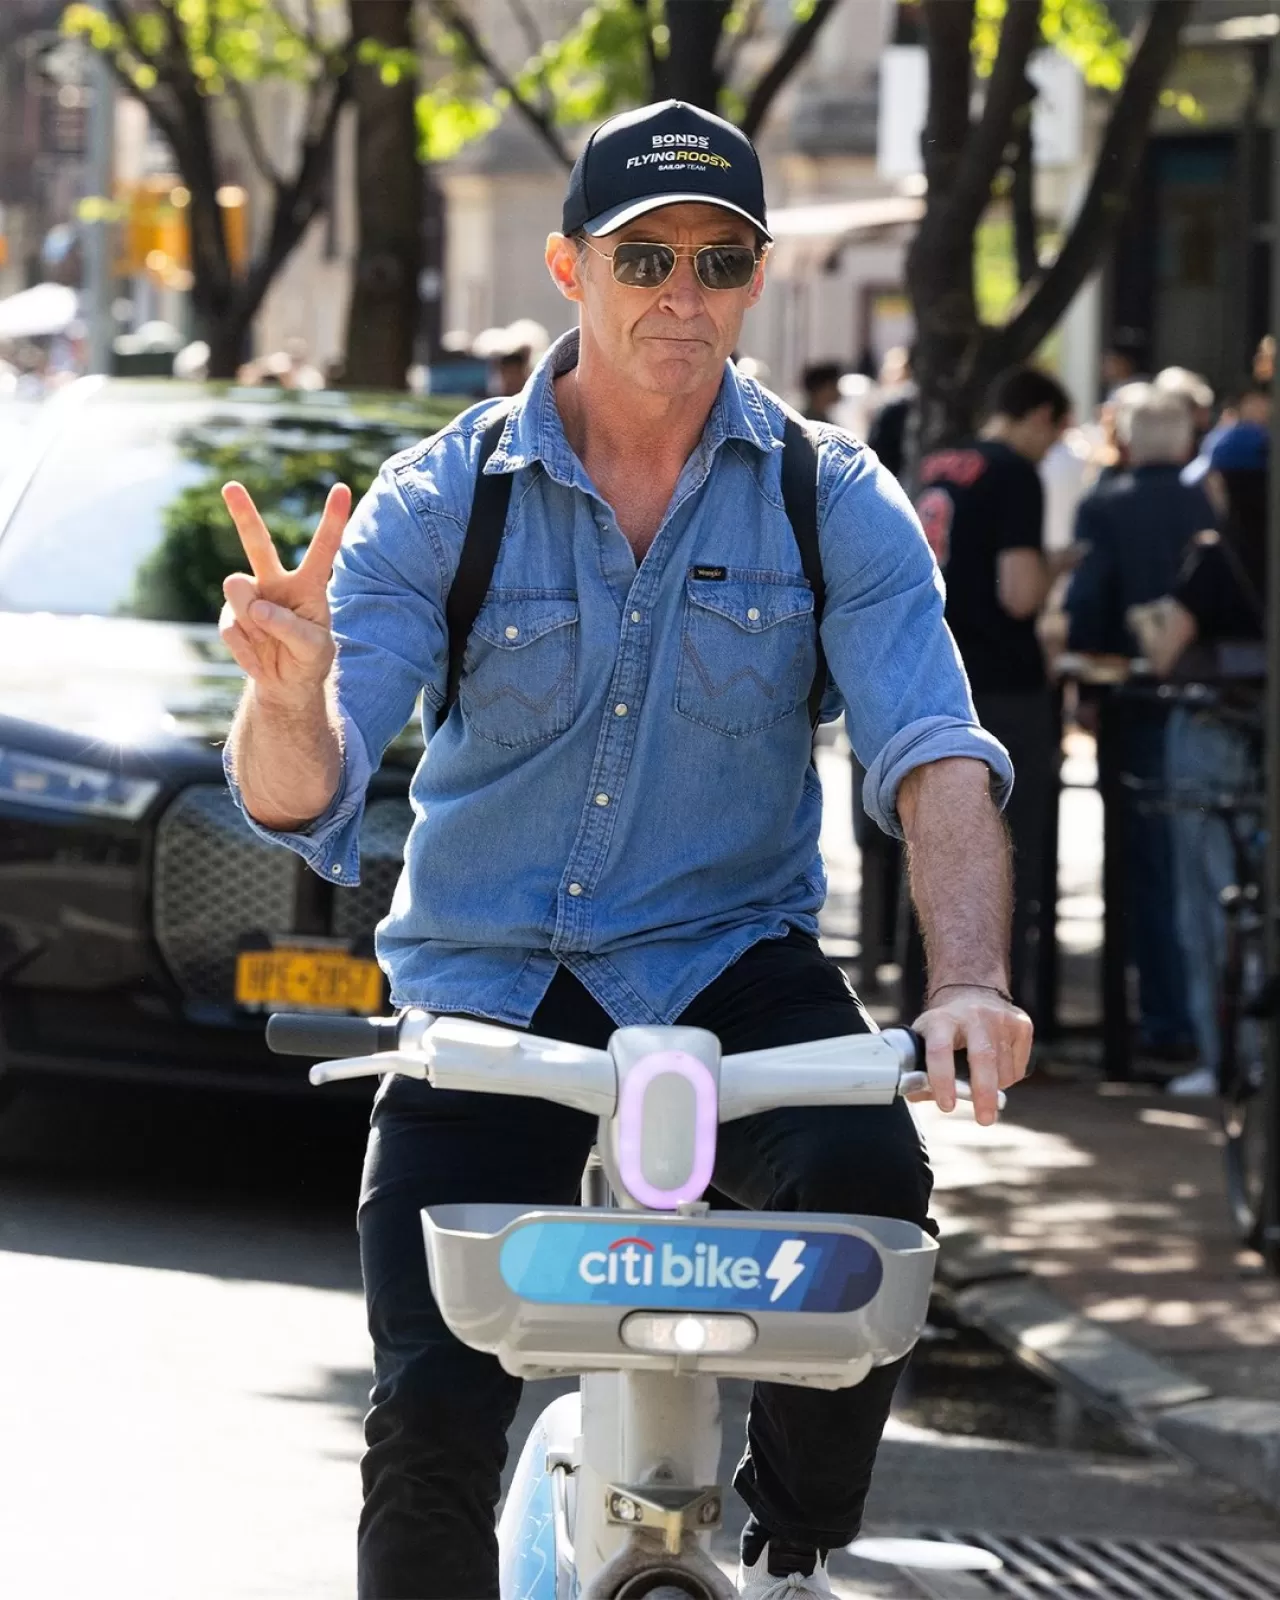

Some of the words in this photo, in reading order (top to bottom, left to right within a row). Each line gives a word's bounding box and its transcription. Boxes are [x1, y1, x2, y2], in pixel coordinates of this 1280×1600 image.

[652, 134, 708, 146] BONDS
[579, 1238, 655, 1286] citi
[661, 1242, 761, 1289] bike
